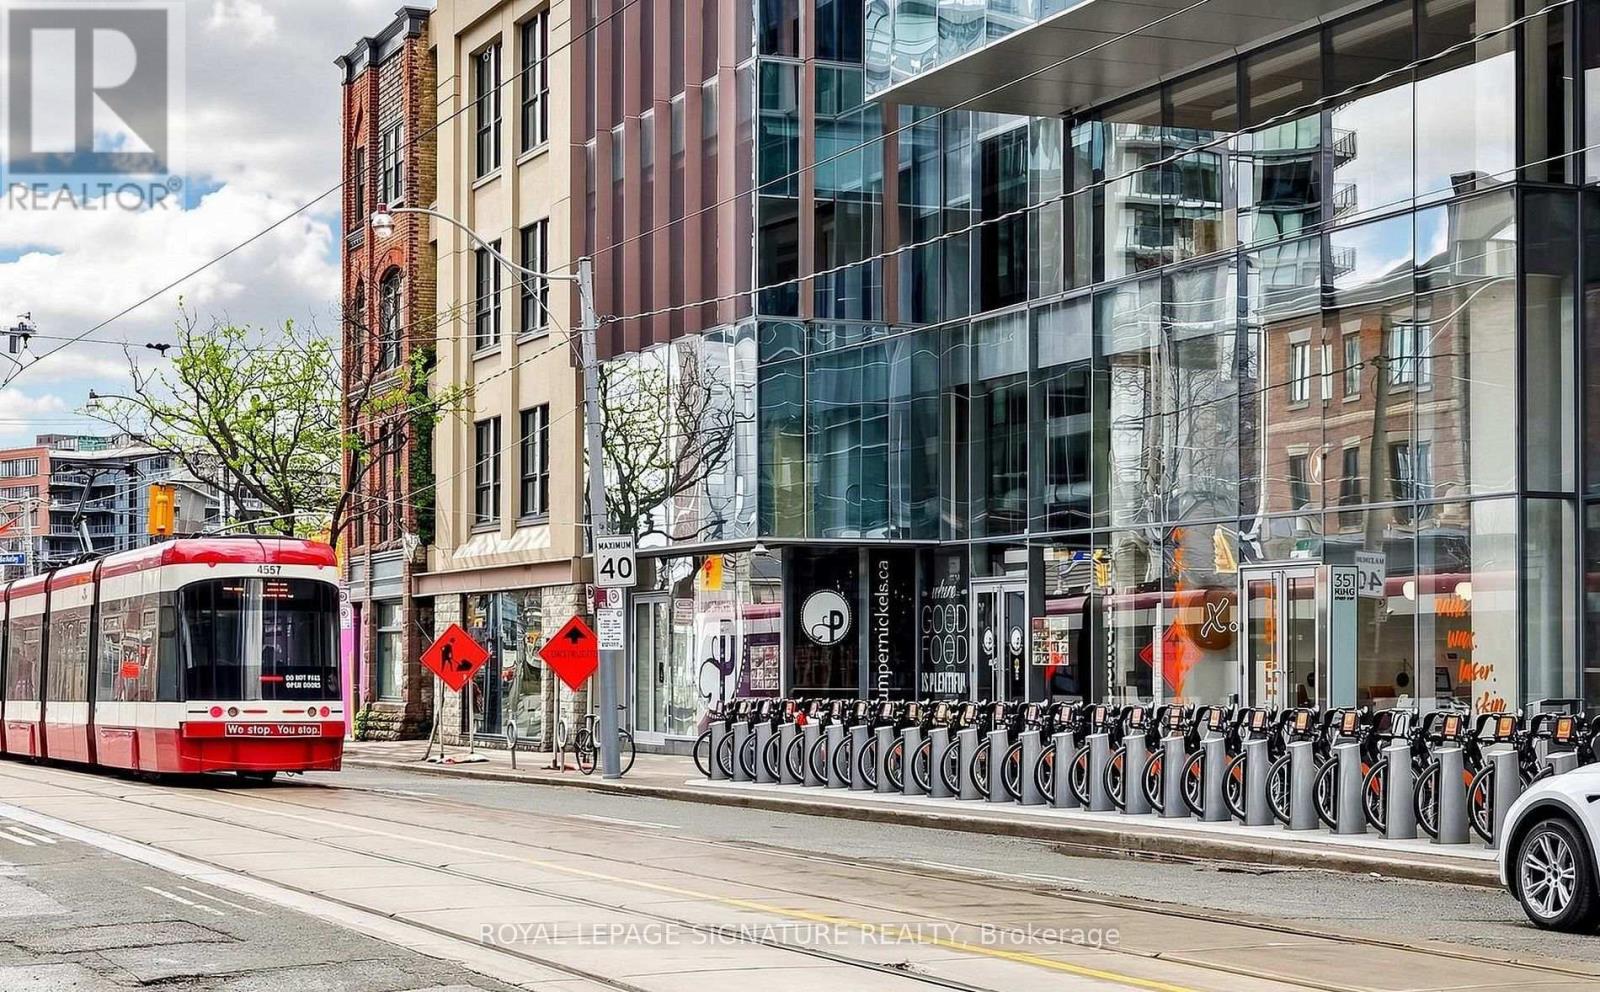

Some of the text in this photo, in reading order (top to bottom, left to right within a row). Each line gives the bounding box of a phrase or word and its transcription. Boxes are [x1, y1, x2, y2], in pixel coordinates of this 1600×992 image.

[598, 541, 632, 550] MAXIMUM
[256, 565, 282, 575] 4557
[599, 556, 633, 579] 40
[1334, 573, 1356, 588] 351
[1334, 587, 1356, 596] KING
[921, 604, 968, 634] GOOD
[874, 560, 893, 704] umpernickels.ca
[921, 635, 968, 664] FOOD
[921, 672, 929, 692] IS
[227, 724, 321, 737] We stop. You stop.
